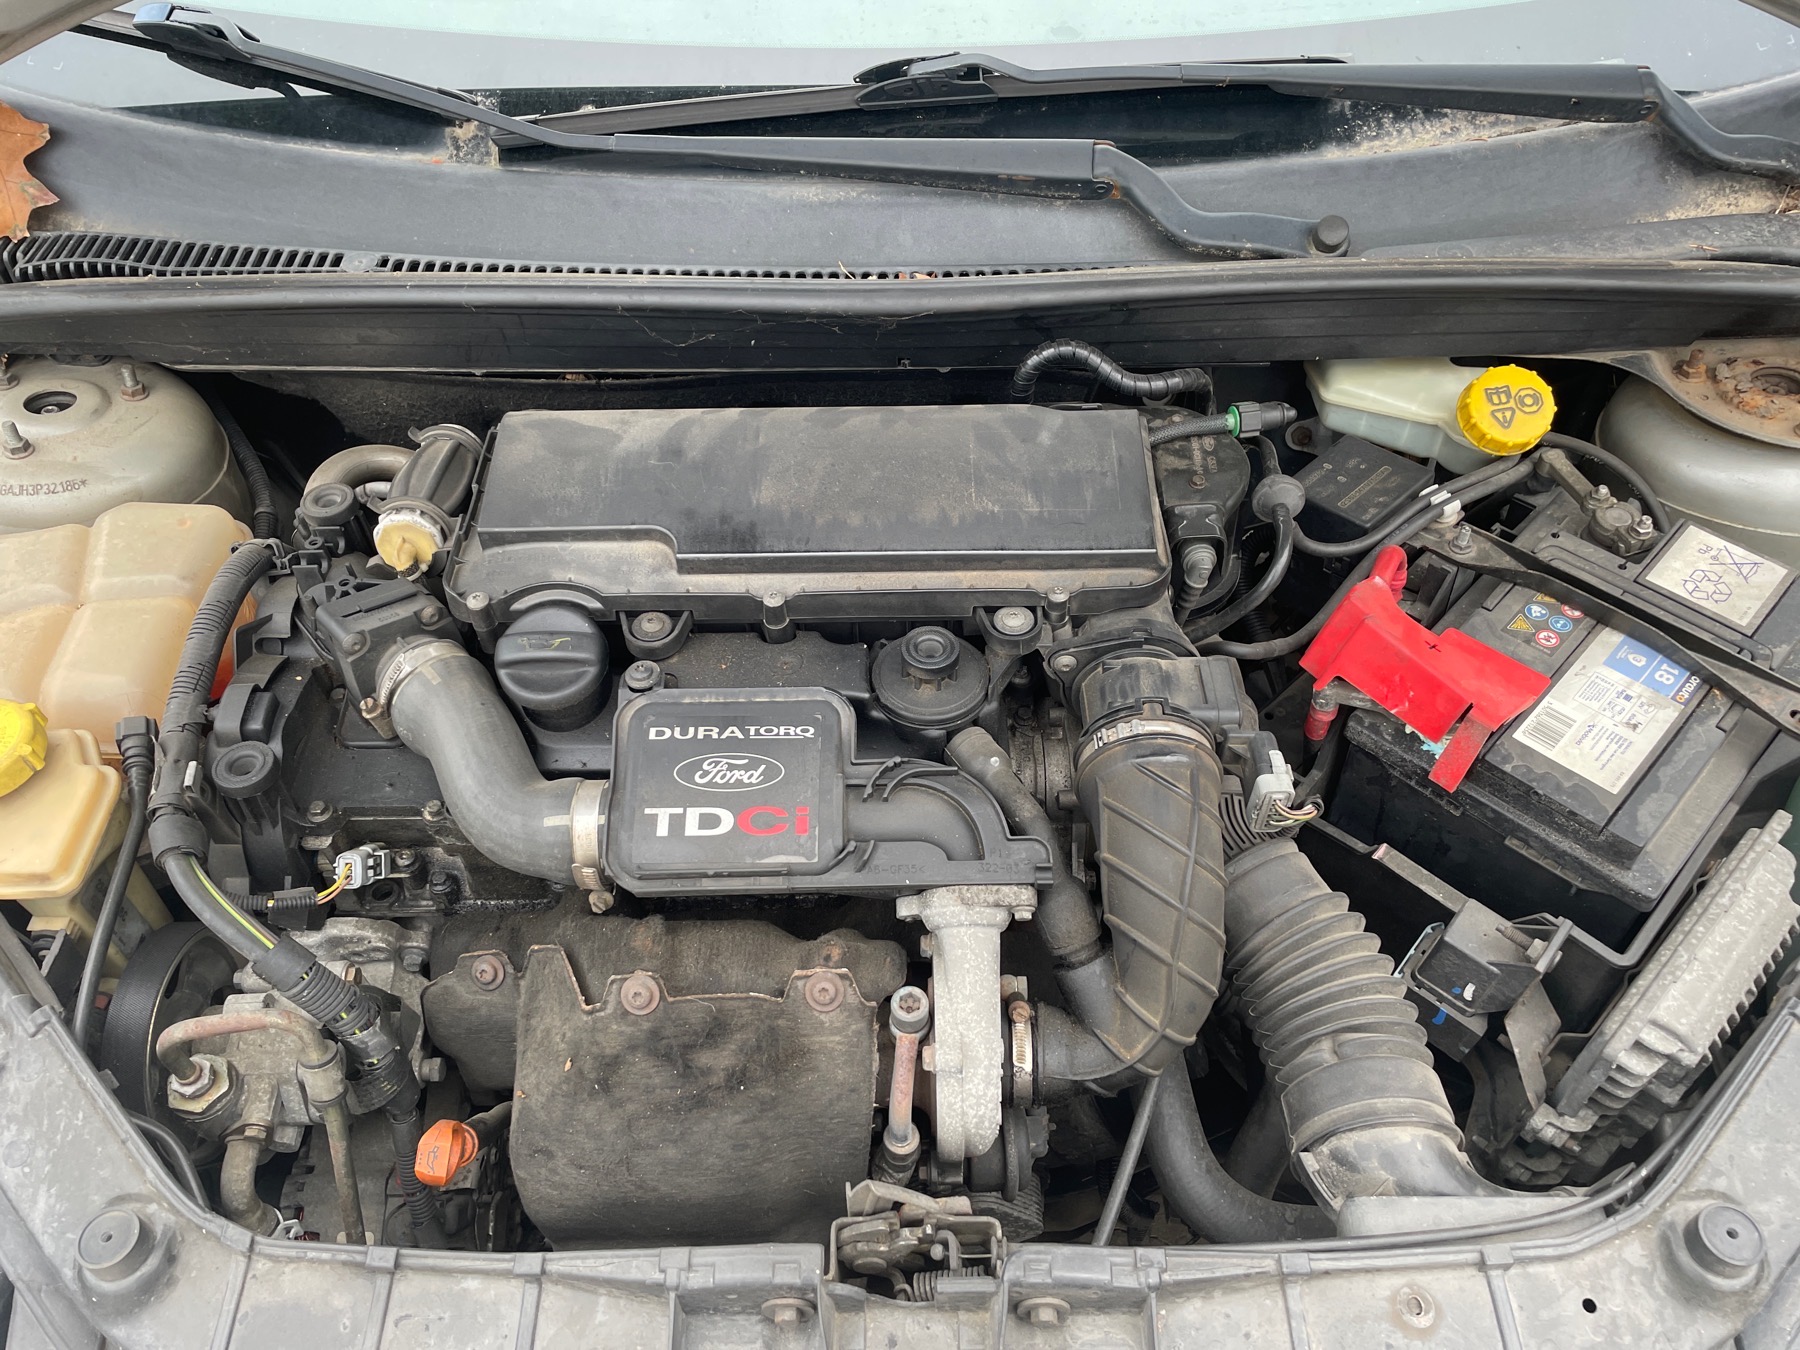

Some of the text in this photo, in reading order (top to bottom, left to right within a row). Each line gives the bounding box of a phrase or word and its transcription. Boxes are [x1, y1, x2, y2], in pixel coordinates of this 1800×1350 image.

[1698, 543, 1713, 554] Pb
[1654, 663, 1679, 685] 18
[1676, 675, 1700, 703] orauto
[648, 725, 815, 740] DURATORQ
[694, 757, 767, 784] Ford
[644, 806, 810, 837] TDCi
